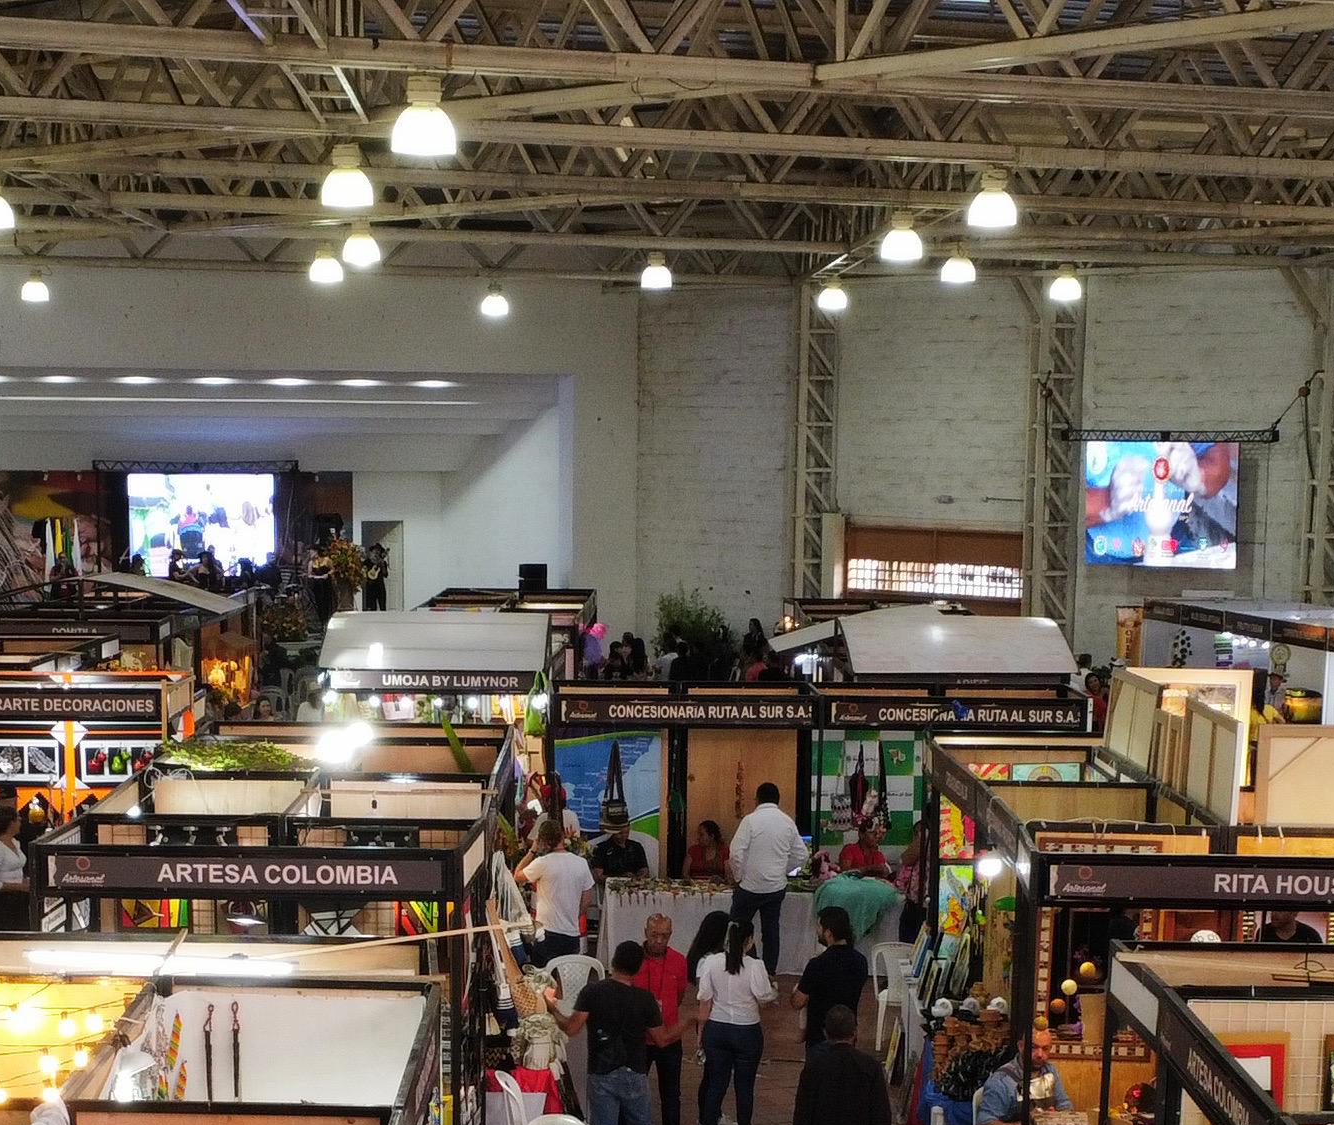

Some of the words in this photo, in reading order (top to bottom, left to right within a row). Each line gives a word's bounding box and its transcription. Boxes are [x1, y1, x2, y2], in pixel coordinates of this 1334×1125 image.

[382, 675, 429, 687] UMOJA
[432, 675, 451, 687] BY
[453, 676, 519, 688] LUMYNOR
[43, 697, 154, 713] DECORACIONES
[708, 704, 739, 719] RUTA
[741, 704, 756, 719] AL
[759, 705, 783, 719] SUR
[978, 709, 1008, 723] RUTA
[1010, 709, 1026, 723] AL
[1029, 709, 1053, 724] SUR
[157, 863, 257, 885] ARTESA
[265, 864, 399, 886] COLOMBIA
[1214, 873, 1269, 894] RITA
[1186, 1047, 1213, 1099] ARTESA
